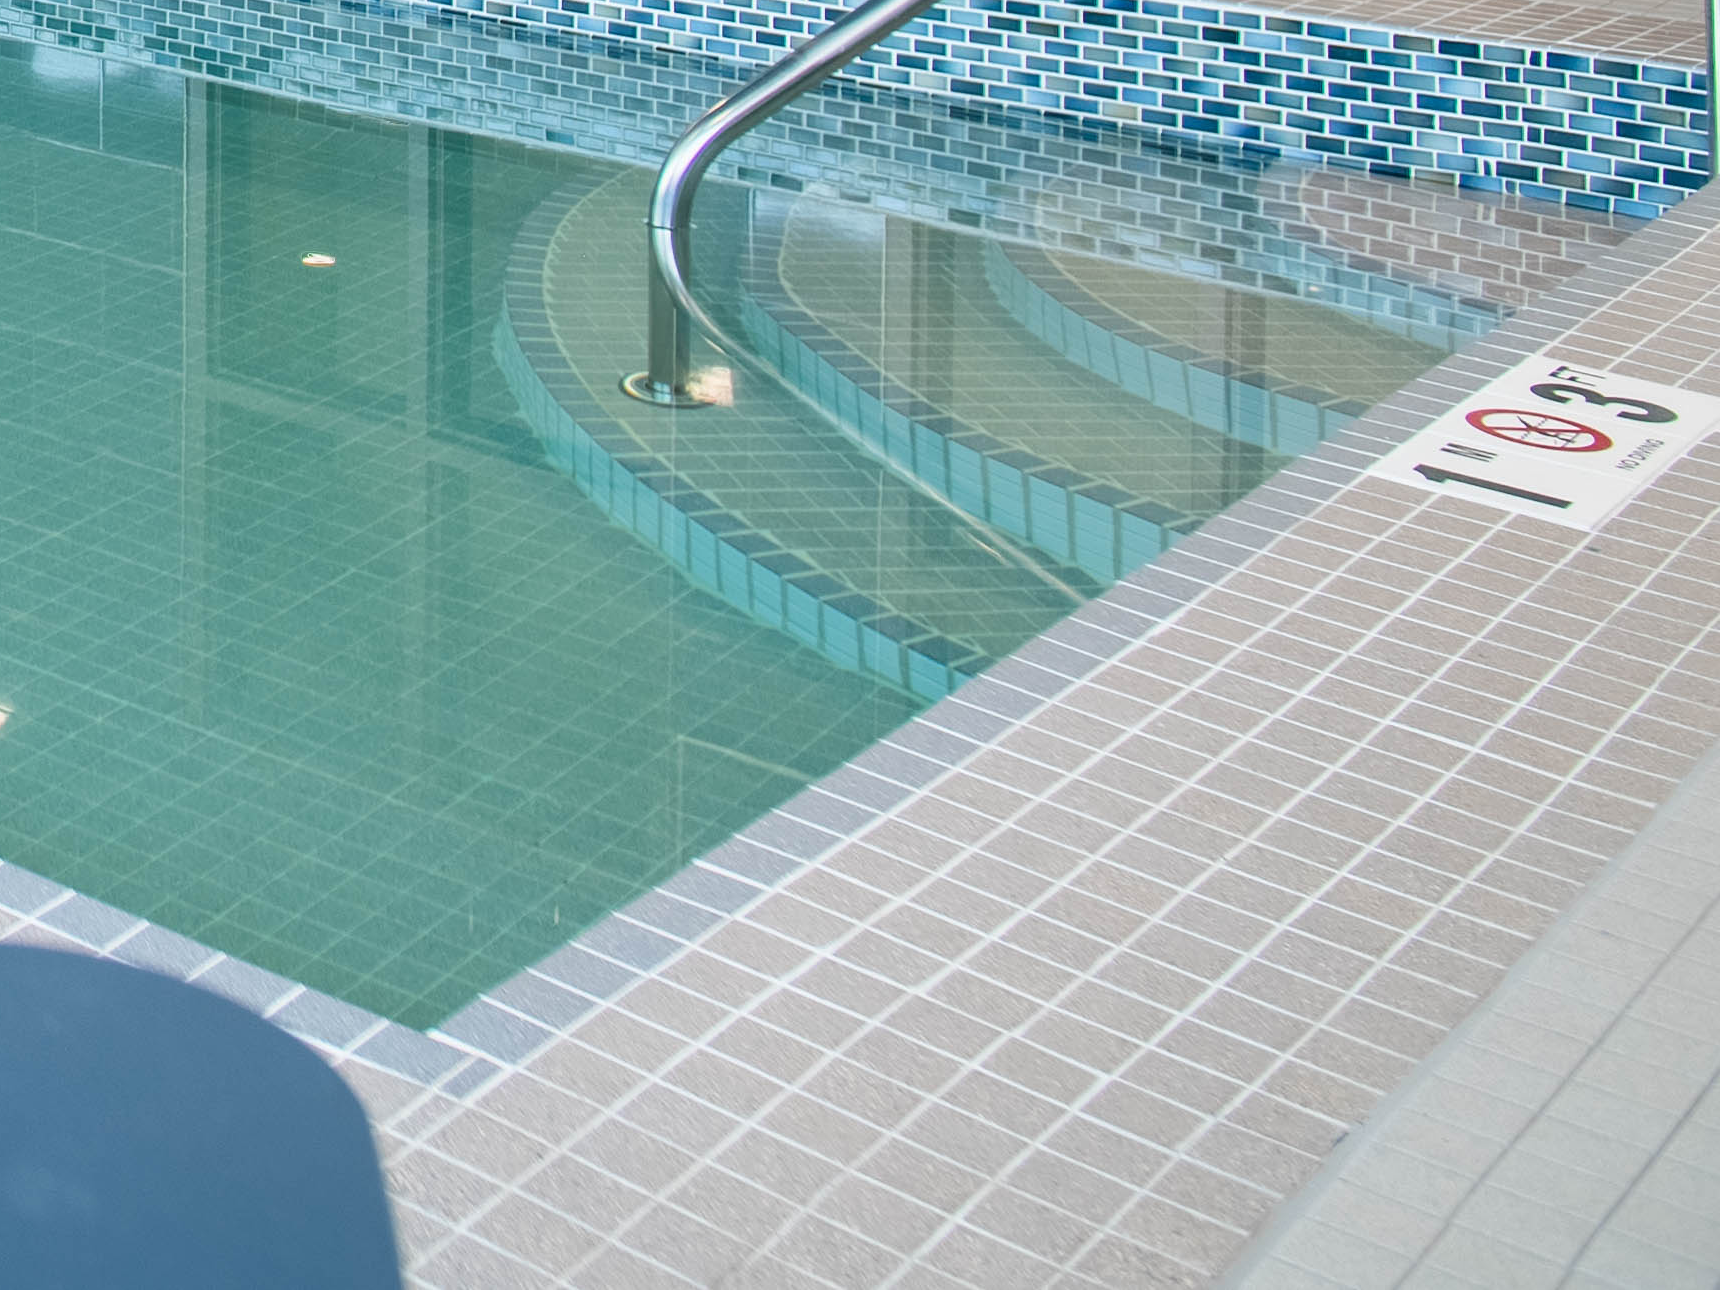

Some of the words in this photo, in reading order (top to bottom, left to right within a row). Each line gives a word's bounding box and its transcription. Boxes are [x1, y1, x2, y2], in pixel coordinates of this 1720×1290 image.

[1547, 365, 1606, 387] FT
[1529, 382, 1679, 424] 3
[1440, 442, 1498, 463] M
[1615, 457, 1638, 472] NO
[1636, 437, 1666, 462] DIVING
[1412, 463, 1574, 509] 1
